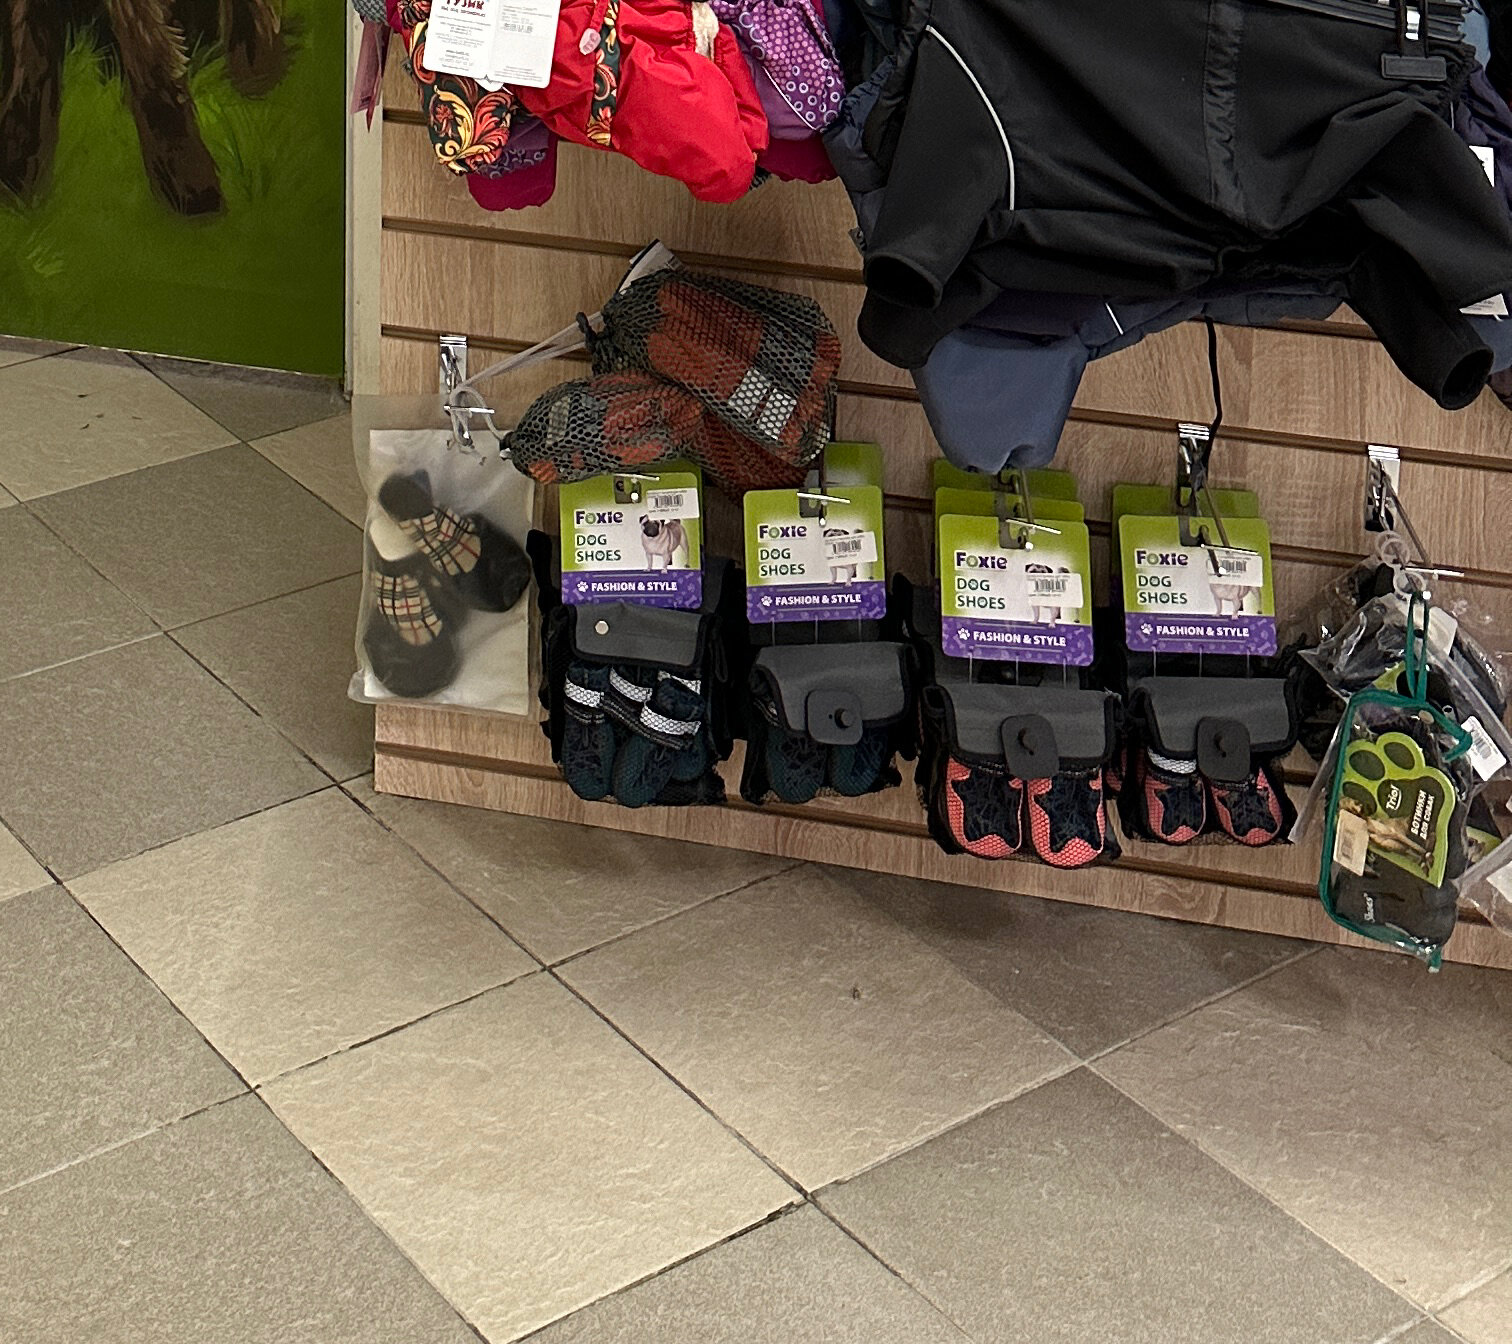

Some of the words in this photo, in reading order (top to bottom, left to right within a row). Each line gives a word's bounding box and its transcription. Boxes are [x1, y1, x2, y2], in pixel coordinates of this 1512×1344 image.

[576, 511, 623, 525] Foxie
[759, 525, 807, 538] Foxie
[576, 534, 607, 546] DOG
[576, 550, 621, 562] SHOES
[760, 548, 791, 560] DOG
[1136, 550, 1188, 566] Foxie
[956, 552, 1007, 570] Foxie
[760, 564, 806, 576] SHOES
[591, 582, 636, 592] FASHION
[638, 582, 646, 591] &
[647, 582, 678, 591] STYLE
[957, 577, 990, 591] DOG
[1138, 575, 1172, 588] DOG
[775, 596, 820, 606] FASHION
[821, 595, 829, 604] &
[831, 594, 862, 604] STYLE
[957, 595, 1006, 610] SHOES
[1139, 592, 1188, 604] SHOES
[1156, 625, 1204, 636] FASHION
[1206, 626, 1215, 636] &
[1216, 627, 1250, 638] STYLE
[973, 631, 1021, 644] FASHION
[1023, 634, 1032, 644] &
[1033, 635, 1066, 647] STYLE
